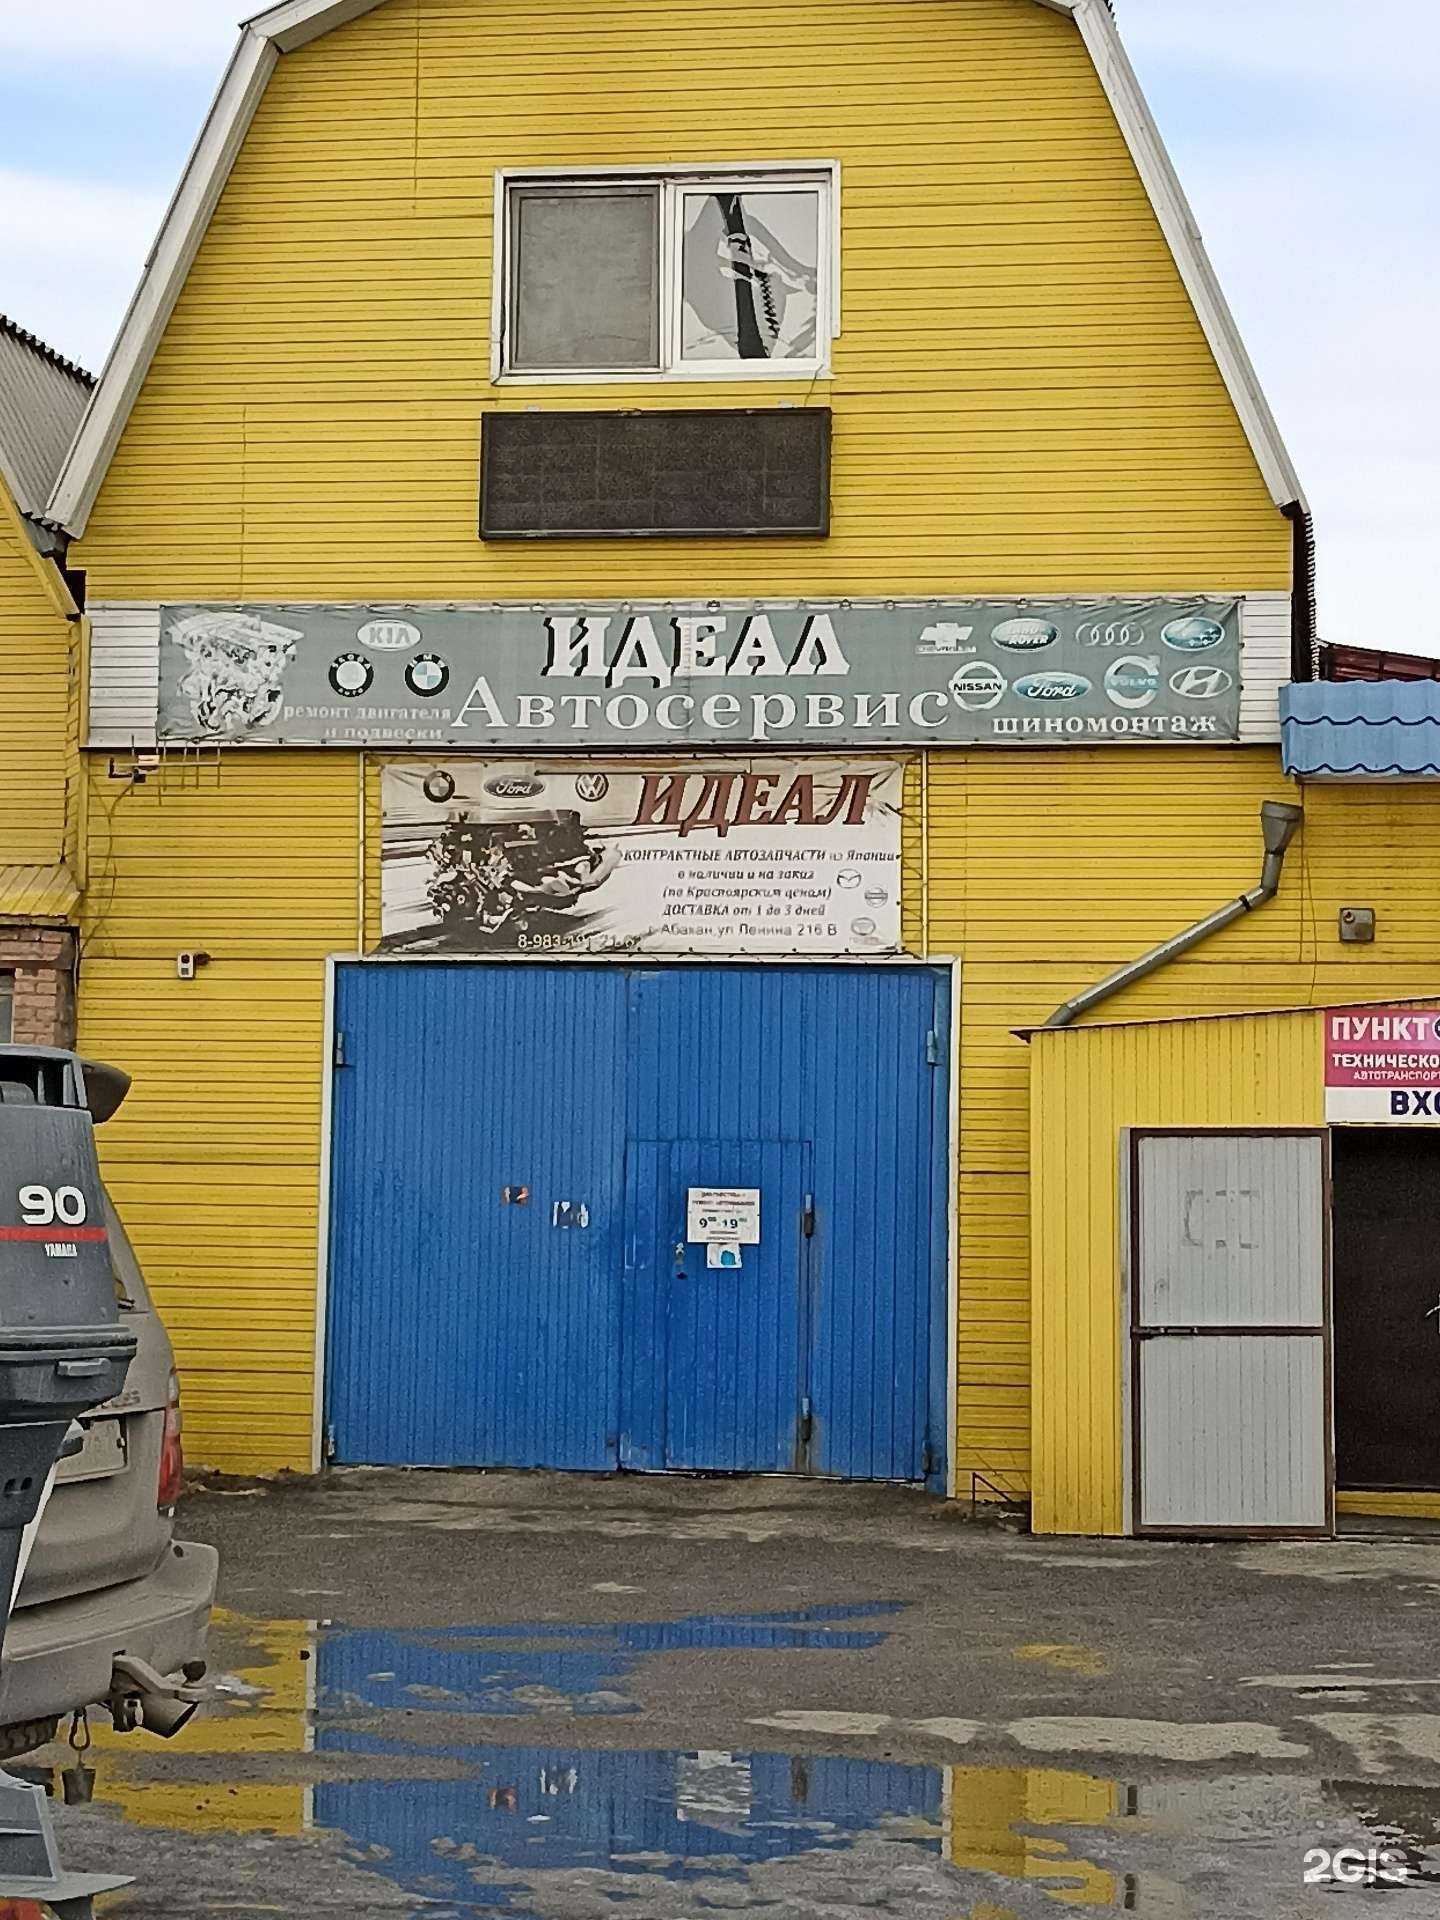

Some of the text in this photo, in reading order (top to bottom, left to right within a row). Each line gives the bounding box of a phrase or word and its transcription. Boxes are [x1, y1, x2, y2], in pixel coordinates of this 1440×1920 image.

[369, 627, 410, 643] KIA
[541, 614, 850, 689] ИДЕАЛ
[953, 682, 1003, 691] NISSAN
[1027, 678, 1078, 698] Ford
[283, 705, 451, 722] ремонт двигателя
[451, 676, 950, 741] Автосервис
[992, 714, 1217, 735] шиномонтаж
[344, 727, 443, 740] подвески
[495, 780, 533, 796] Ford
[632, 774, 879, 837] ИДЕАЛ
[623, 849, 722, 861] КОНТРАКТНЫЕ
[725, 849, 826, 861] АВТОЗАПЧАСТИ
[846, 849, 895, 861] Японии
[688, 870, 744, 880] наличии
[747, 870, 756, 880] и
[758, 870, 774, 880] на
[778, 870, 815, 880] заказ
[662, 886, 832, 900] (по Красноярским ценам)
[663, 904, 825, 916] ДОСТАВКА от 1 до 3 дней
[739, 924, 793, 936] Ленина
[1332, 1016, 1430, 1040] ПУНКТ
[1332, 1053, 1440, 1068] ТЕХНИЧЕСКО
[18, 1184, 87, 1225] 90
